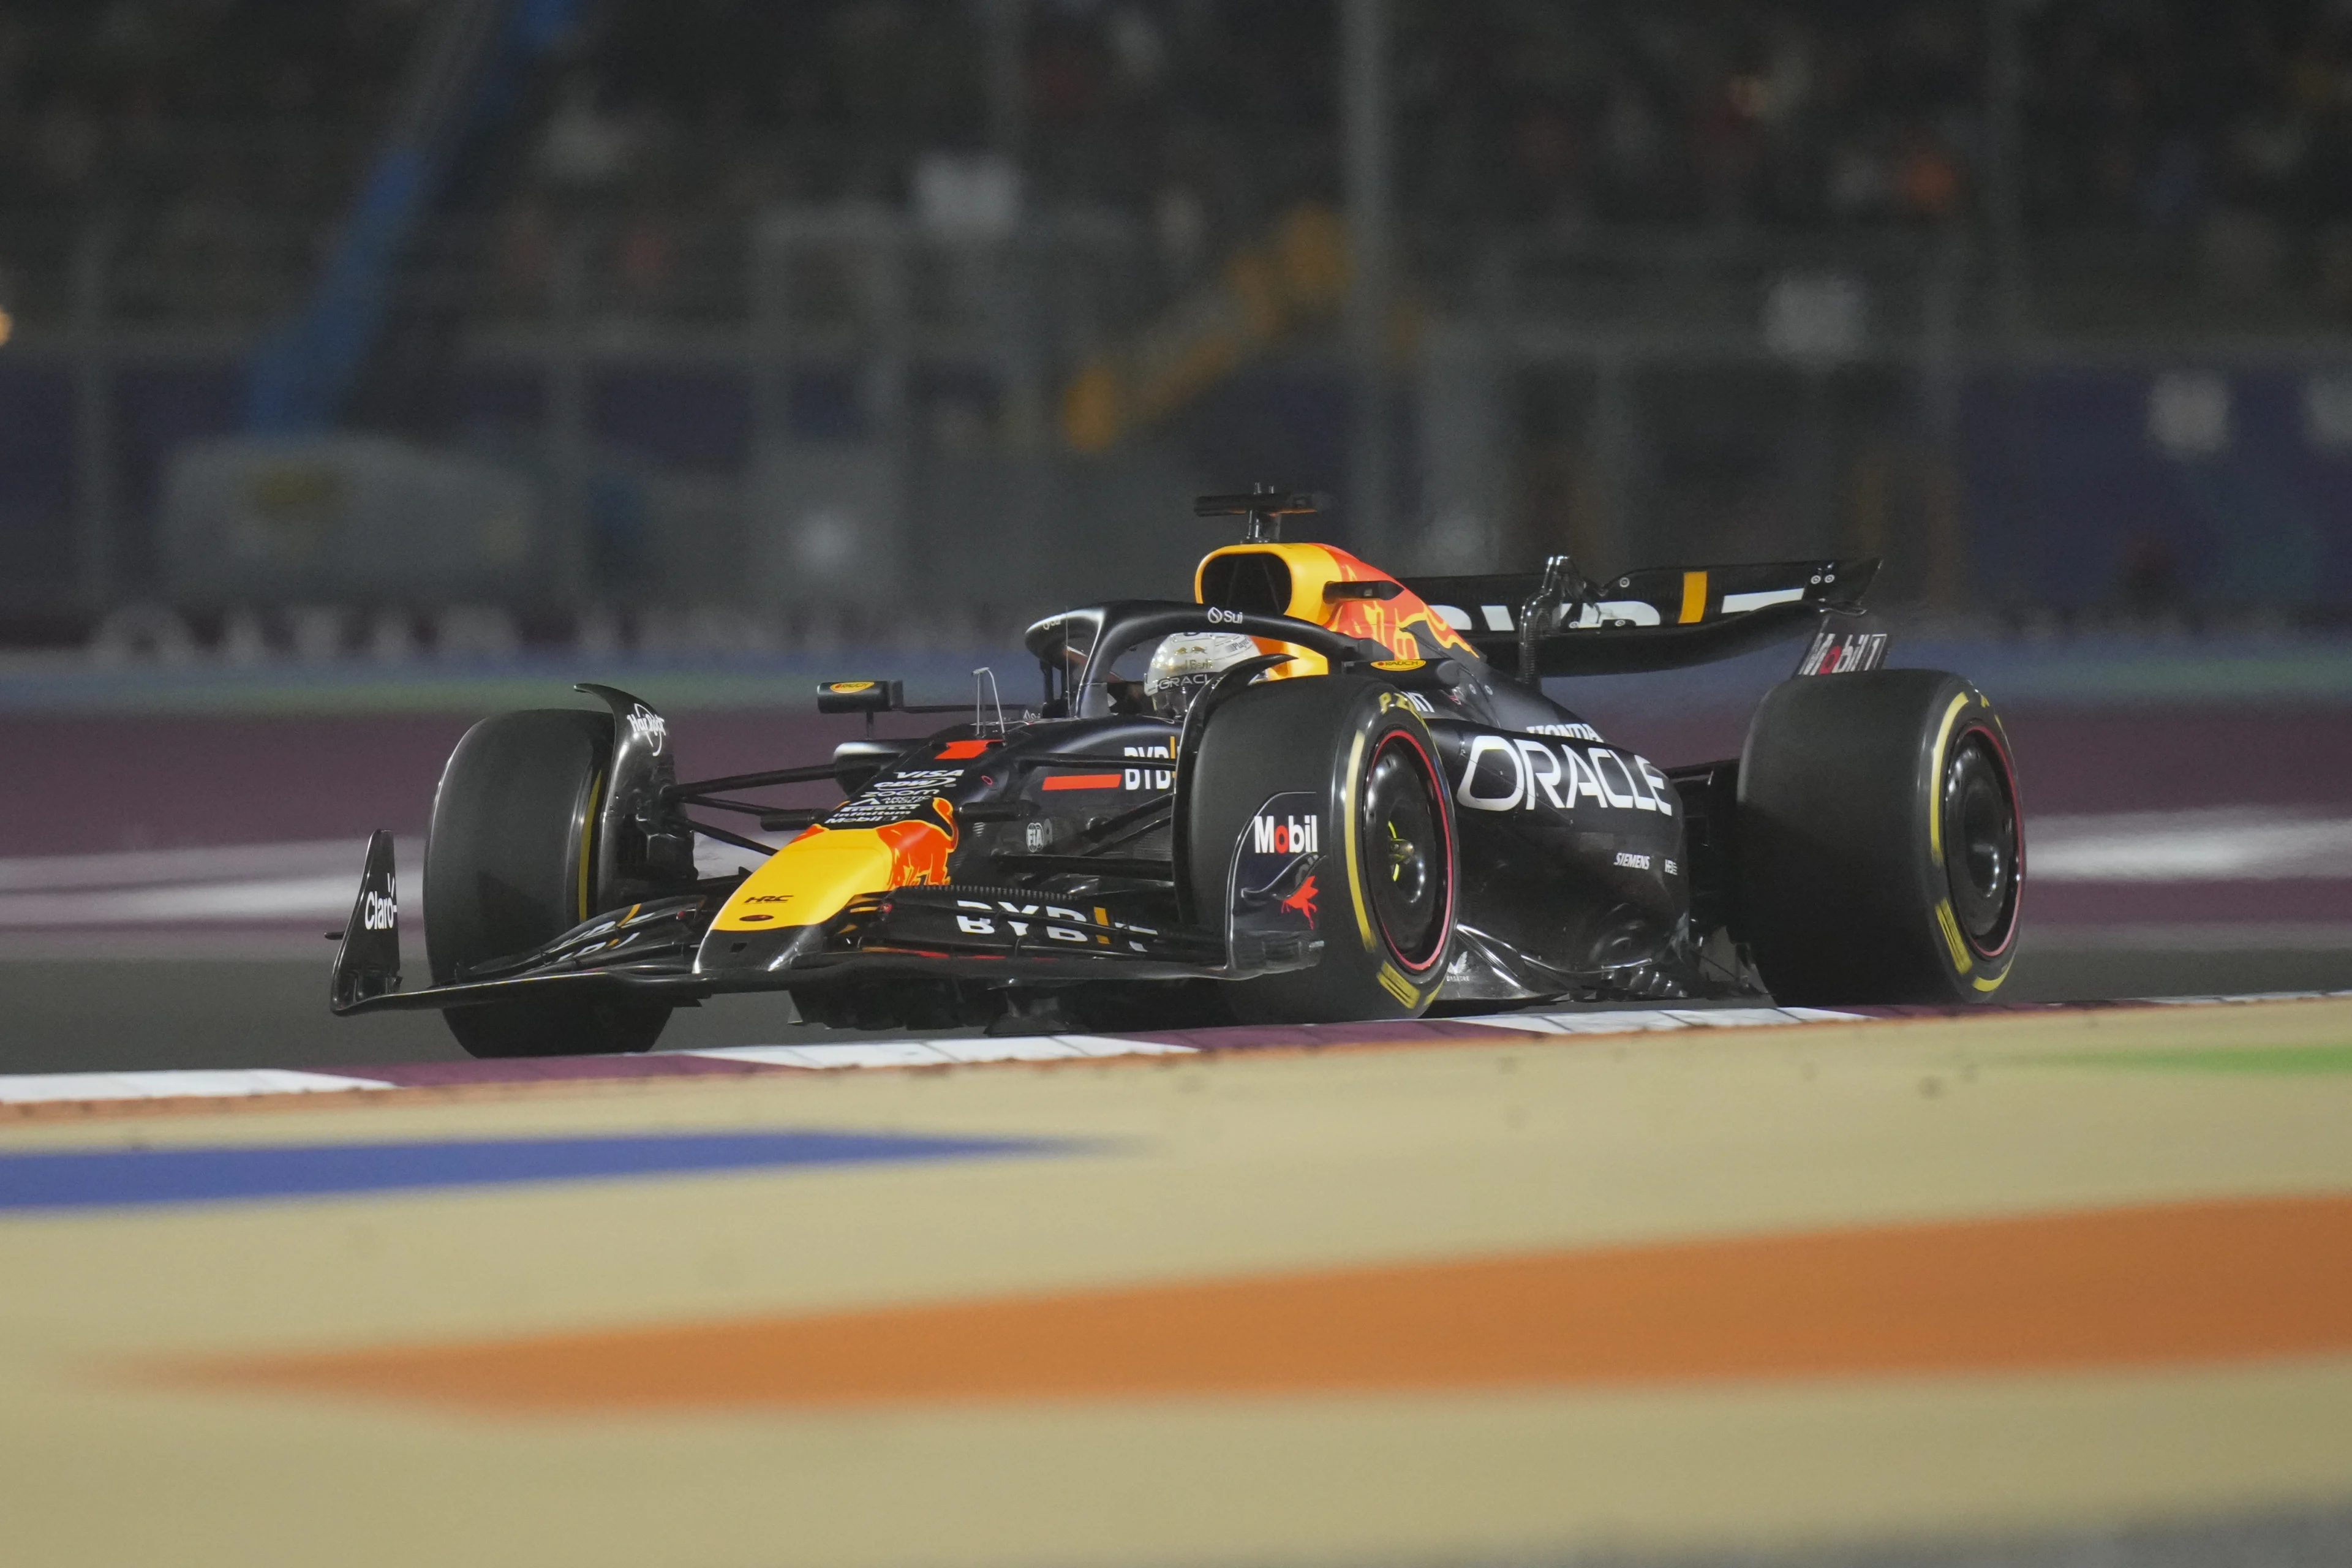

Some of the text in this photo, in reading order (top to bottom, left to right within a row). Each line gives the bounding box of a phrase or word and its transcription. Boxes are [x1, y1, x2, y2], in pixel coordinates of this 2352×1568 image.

[1224, 610, 1243, 624] Sui
[1798, 633, 1870, 676] Mobil
[894, 769, 965, 778] VISA
[1124, 736, 1177, 791] BYBI
[1457, 735, 1672, 816] ORACLE
[860, 789, 940, 797] zoom
[840, 804, 921, 812] PIRELLI
[1254, 815, 1318, 854] Mobil
[1613, 852, 1650, 870] SIEMENS
[364, 890, 394, 930] Claro
[744, 895, 794, 903] HRC
[956, 900, 1159, 953] BYBIT
